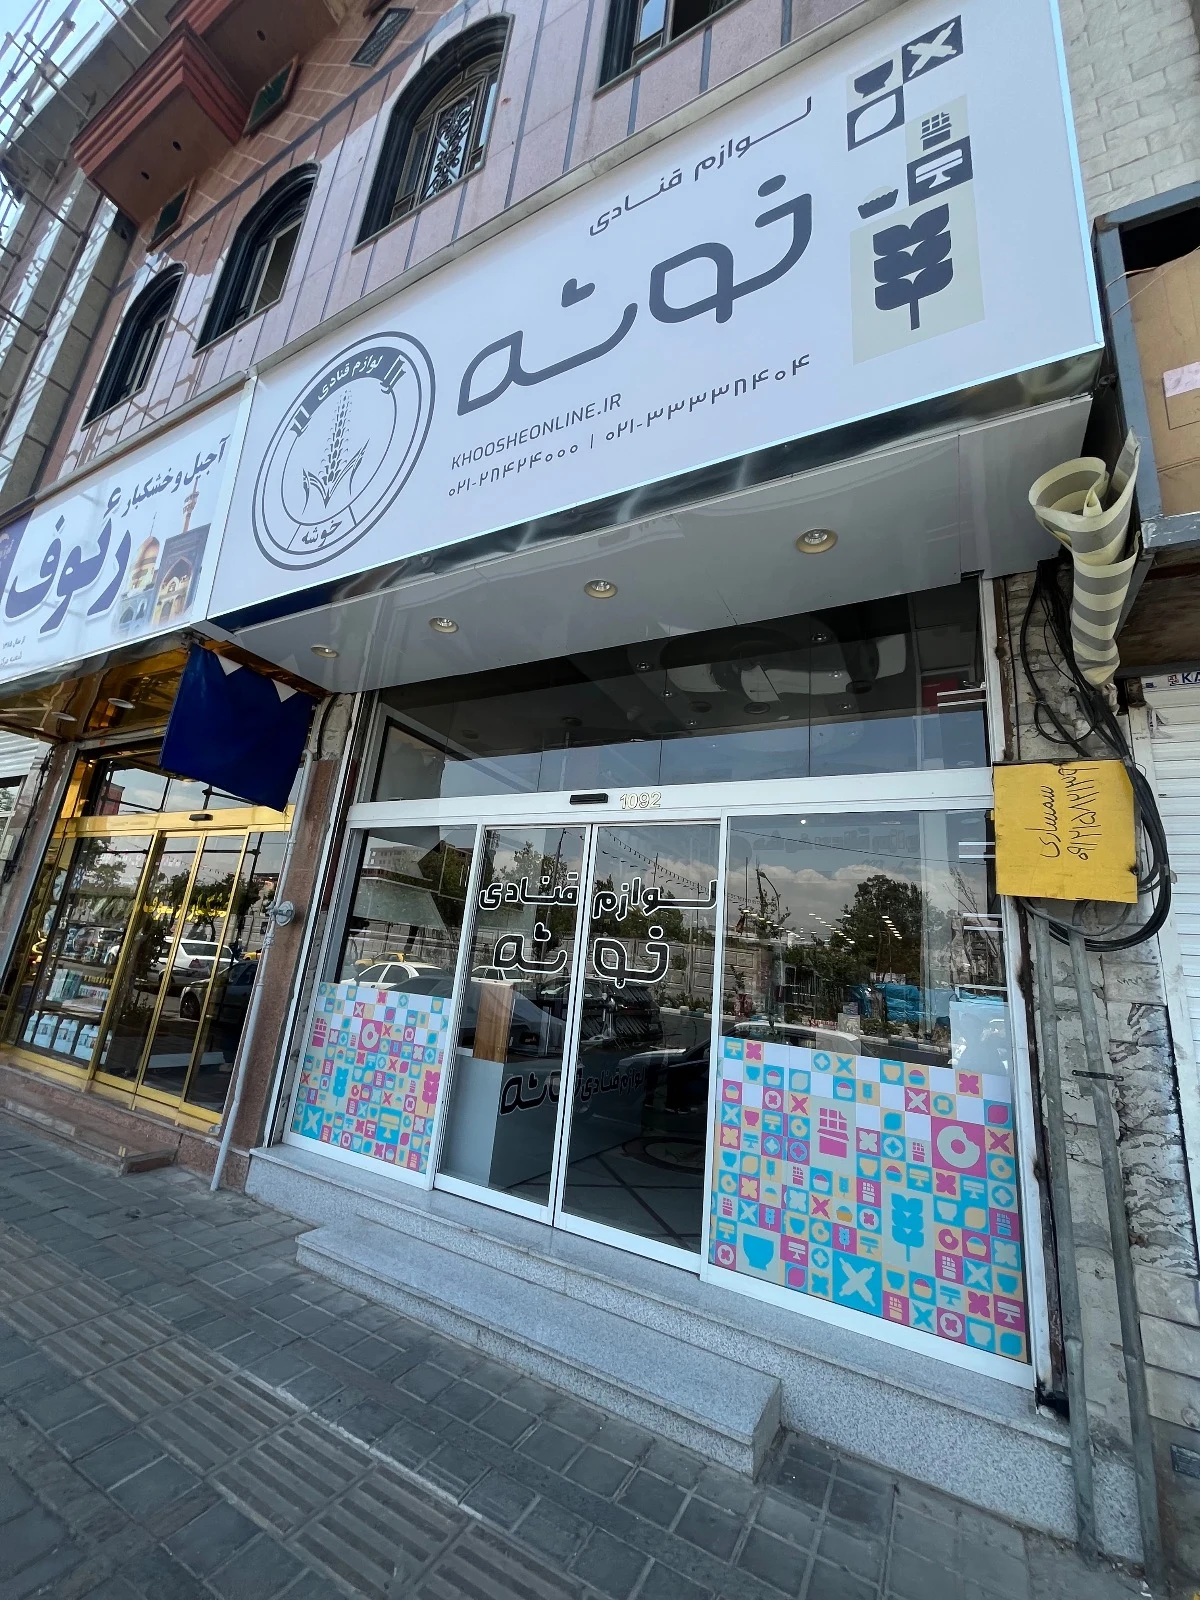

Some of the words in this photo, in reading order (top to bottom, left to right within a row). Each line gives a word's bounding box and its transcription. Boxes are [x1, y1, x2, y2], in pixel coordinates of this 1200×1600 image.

[694, 96, 812, 181] لوازم
[590, 168, 683, 237] قنادی
[457, 174, 813, 416] خوشه
[317, 362, 350, 401] قنادی
[351, 354, 383, 377] لوازم
[451, 393, 622, 470] KHOOSHEONLINE.IR
[183, 434, 231, 486] آجیل
[120, 467, 174, 518] خشکبار
[301, 519, 343, 548] خوشه
[620, 791, 662, 810] 1092
[479, 872, 580, 910] قنادی
[593, 876, 718, 921] لوازم
[493, 922, 670, 989] خوشه
